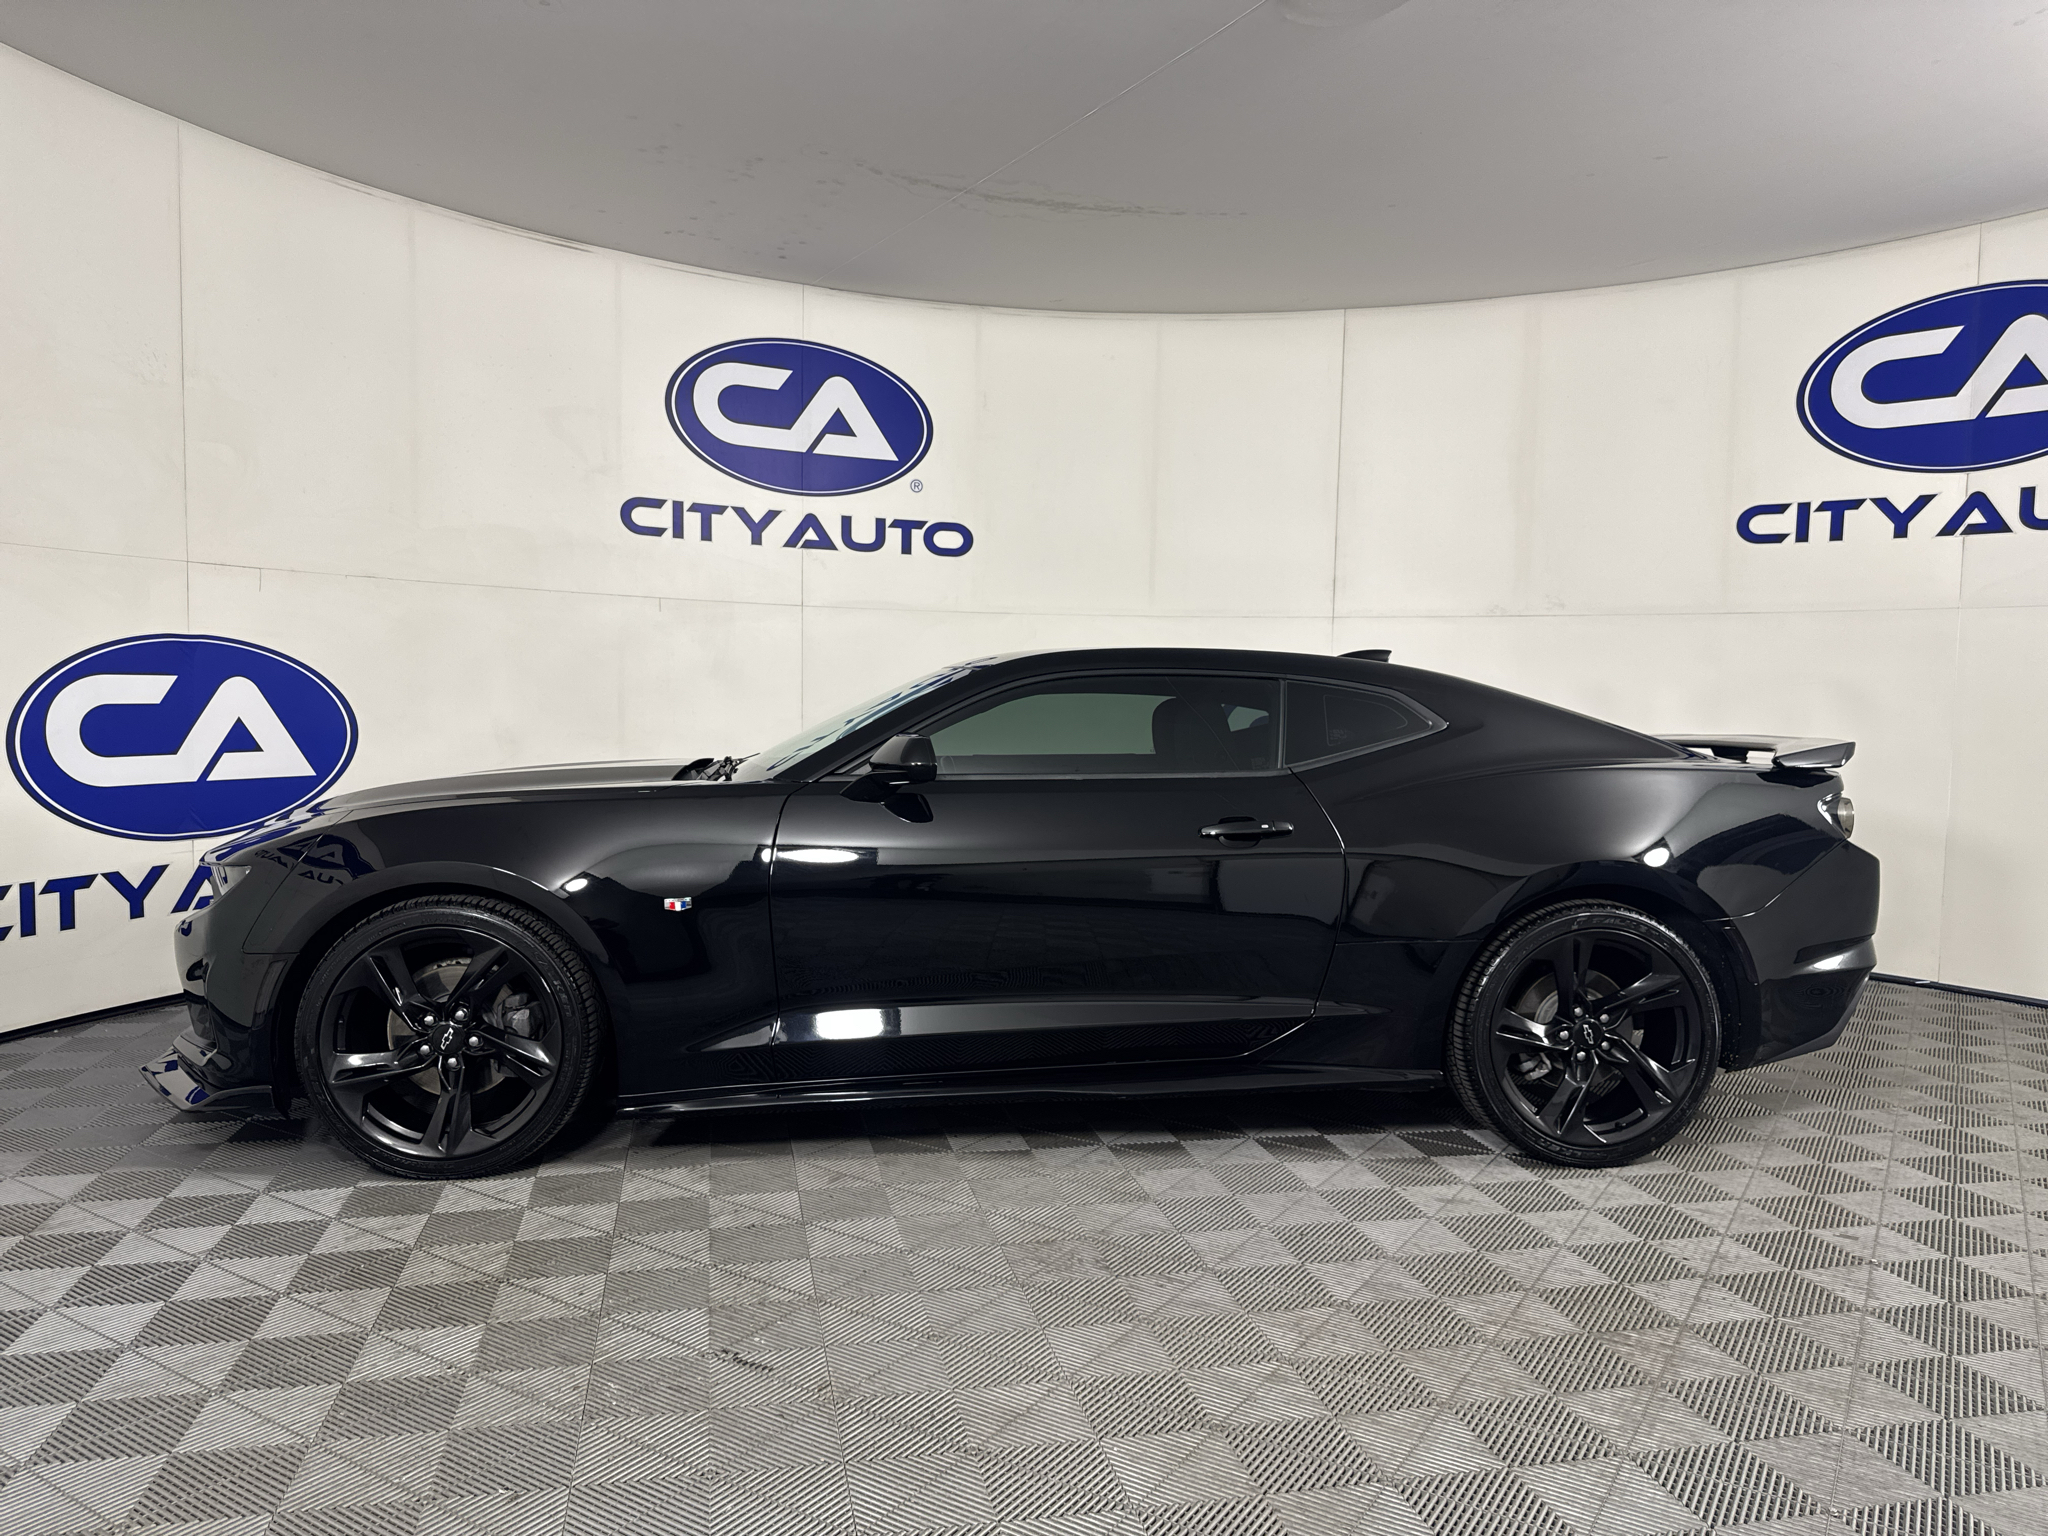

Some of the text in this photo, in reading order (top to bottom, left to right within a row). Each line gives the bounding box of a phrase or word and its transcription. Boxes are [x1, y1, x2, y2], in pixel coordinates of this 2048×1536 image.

[693, 362, 899, 461] CA
[620, 496, 974, 557] CITY AUTO
[1736, 493, 1939, 544] CITY
[45, 674, 317, 788] CA
[0, 864, 170, 941] ITY
